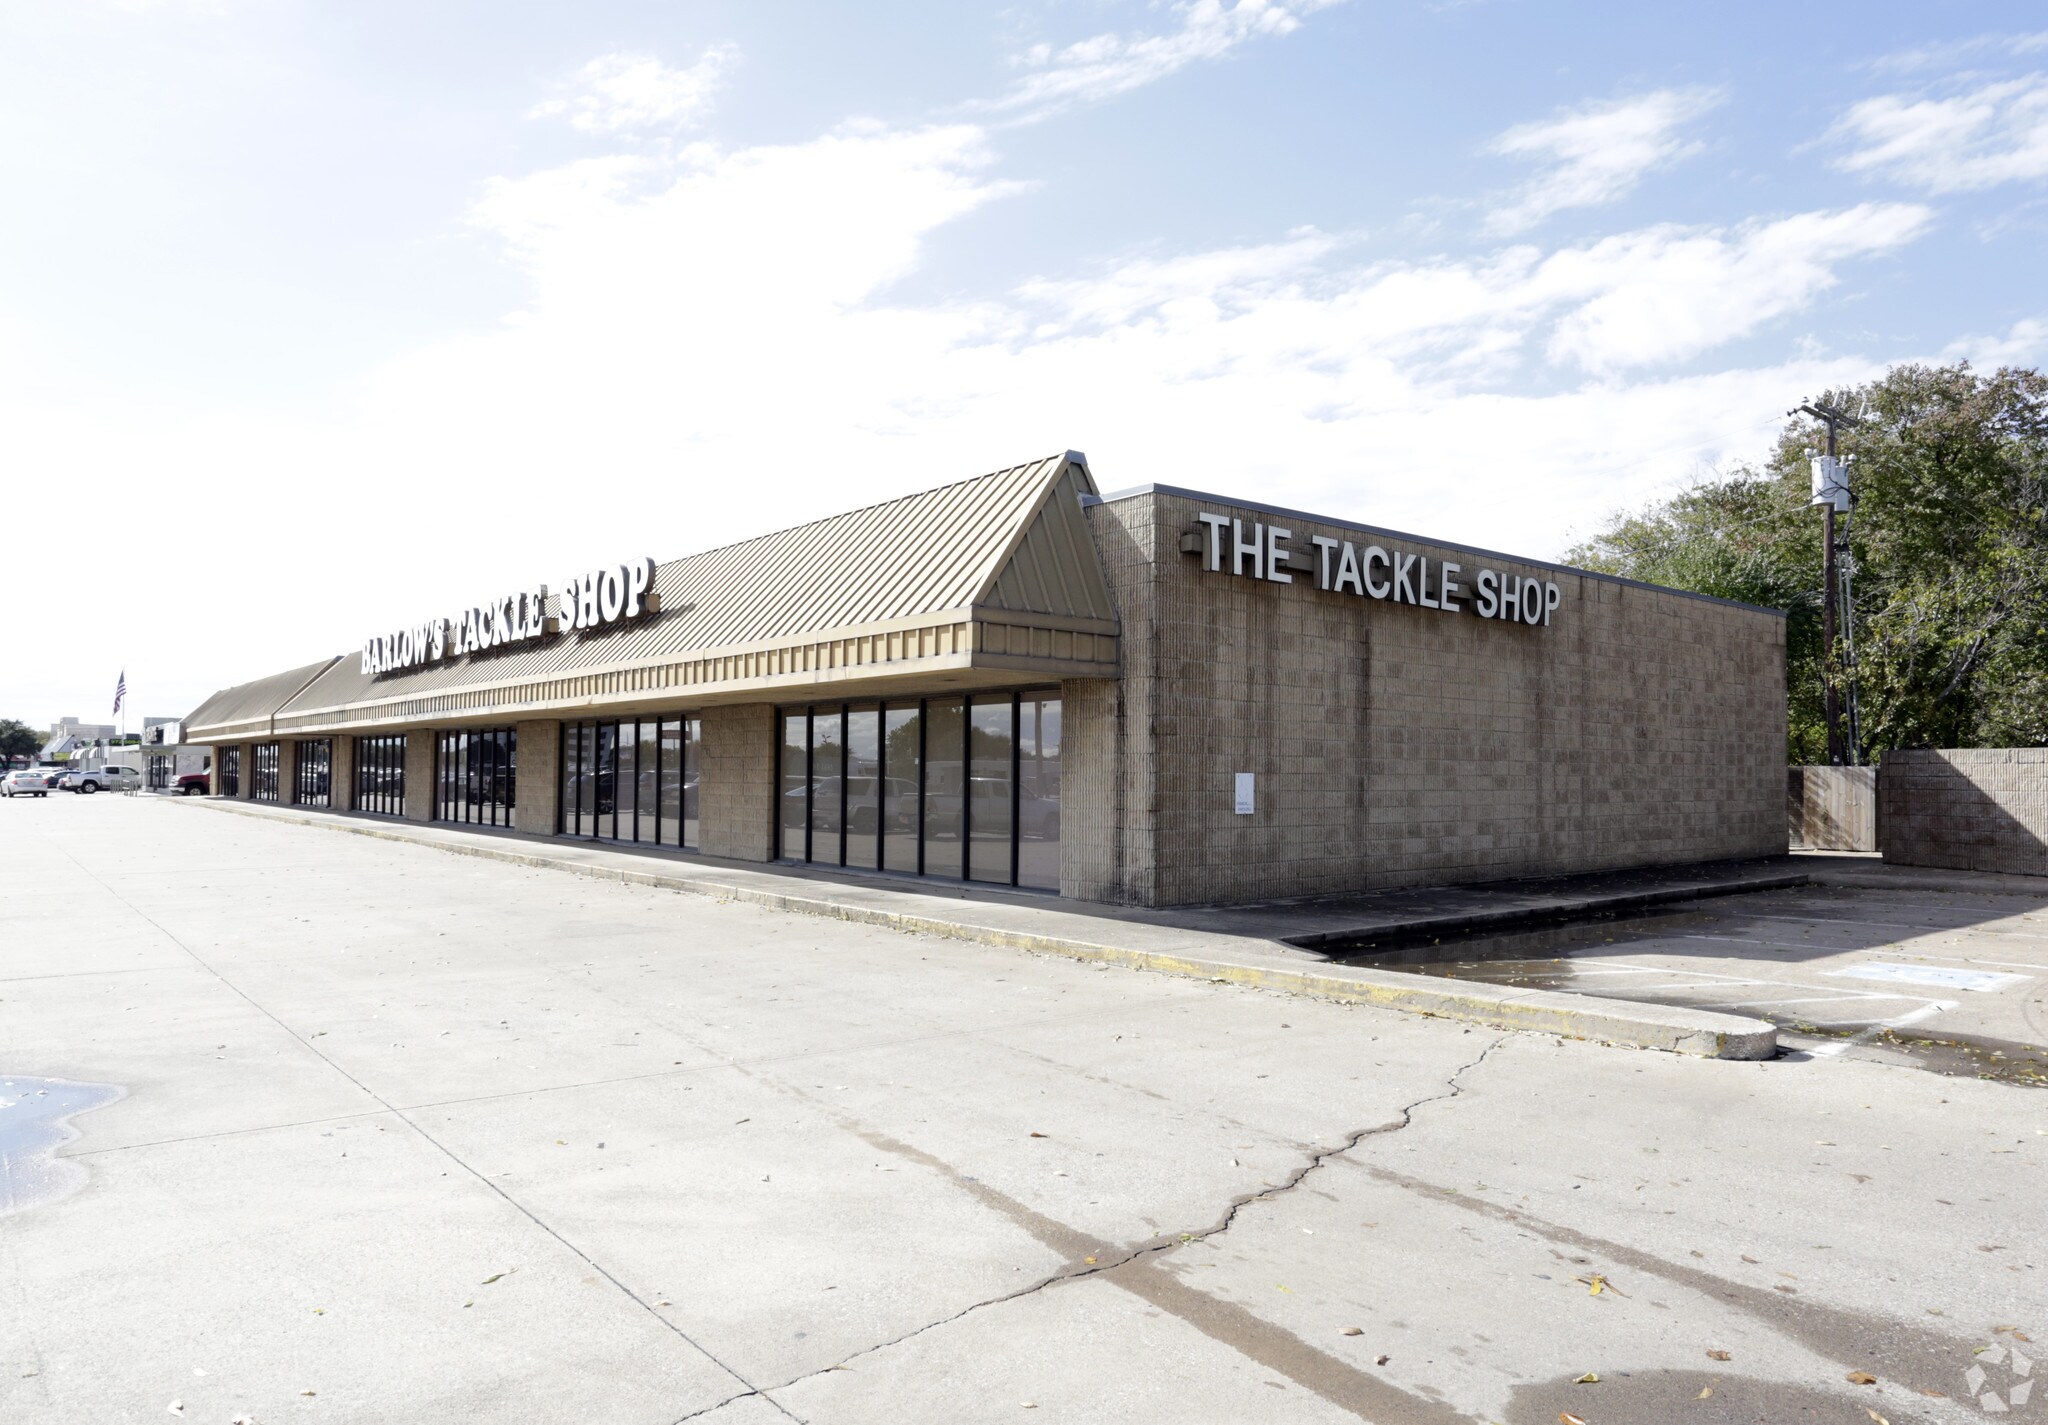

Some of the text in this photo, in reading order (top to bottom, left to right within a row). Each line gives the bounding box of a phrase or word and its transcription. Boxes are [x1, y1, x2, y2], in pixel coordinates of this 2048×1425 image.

[361, 556, 653, 674] BARLOW'S TACKLE SHOP
[1199, 511, 1561, 626] THE TACKLE SHOP
